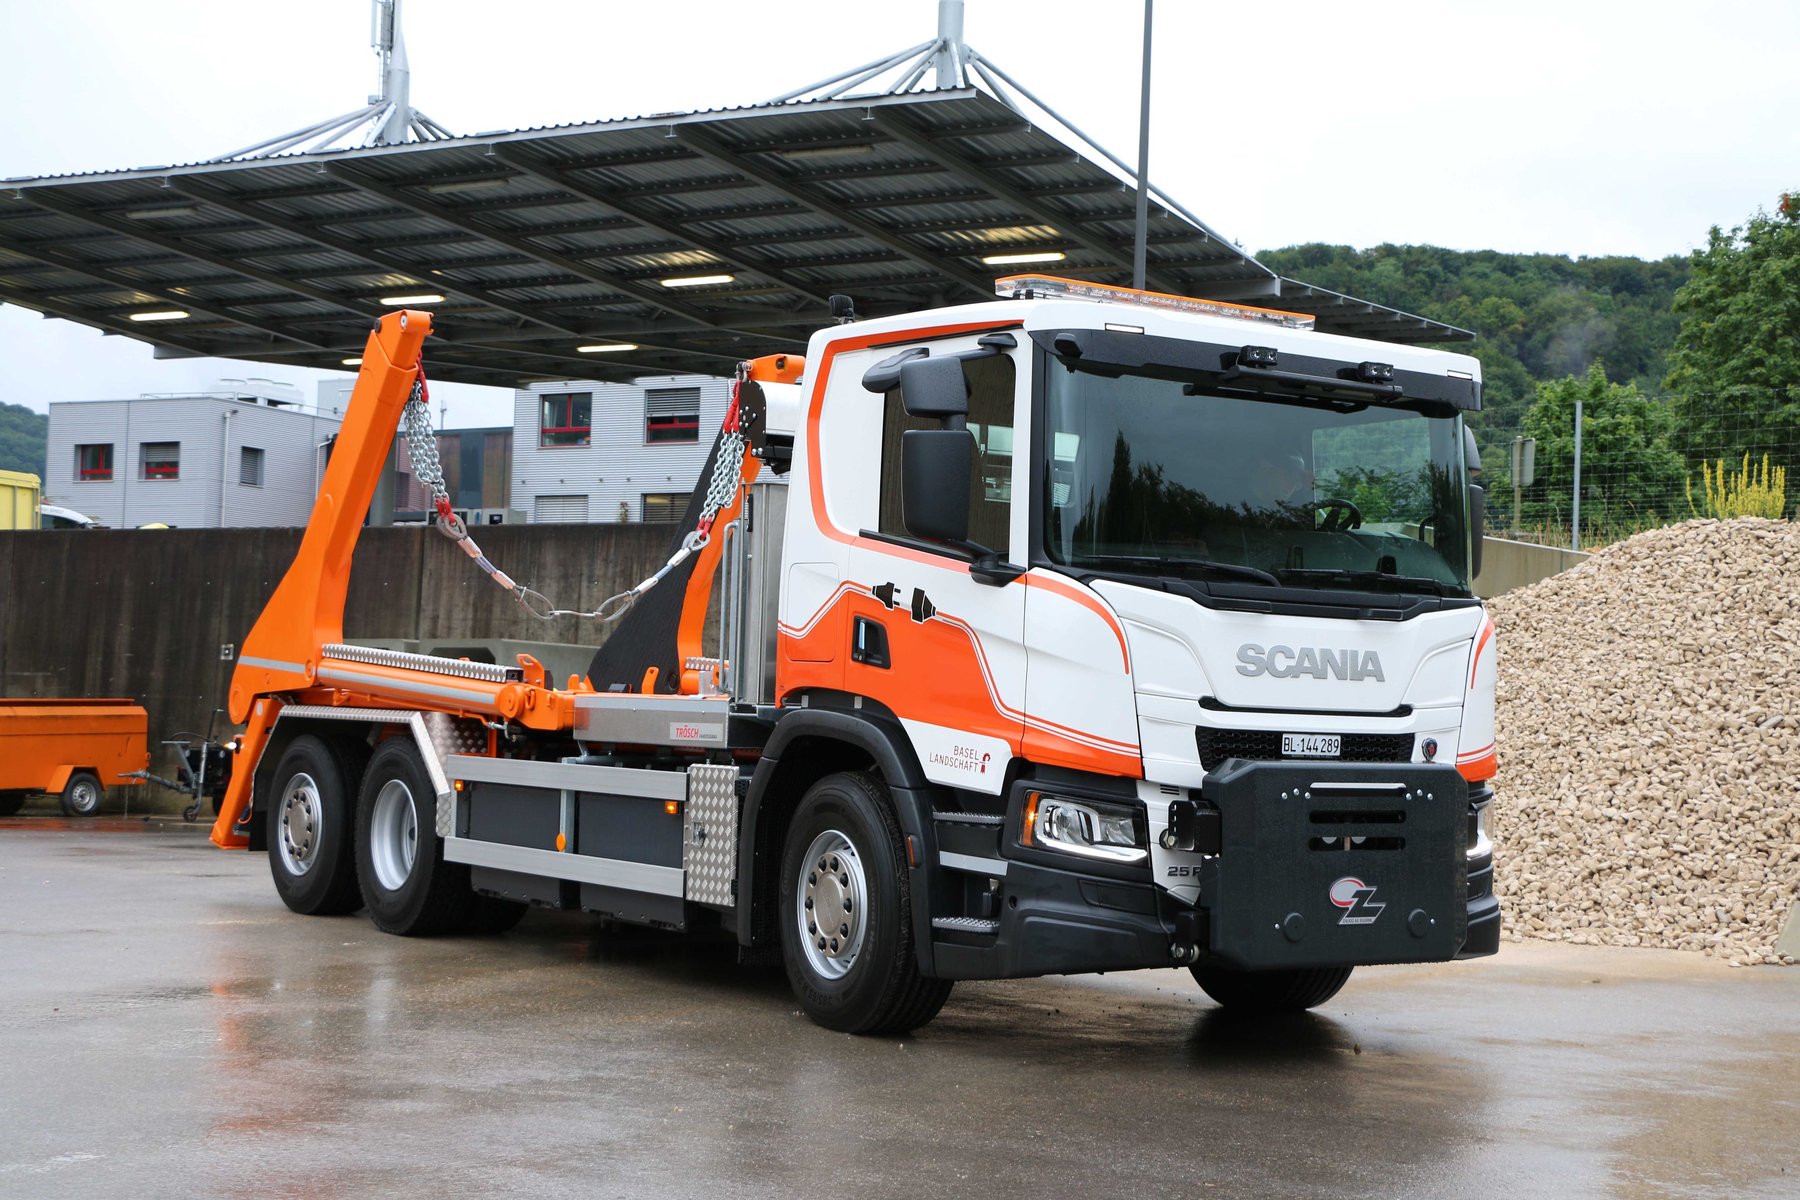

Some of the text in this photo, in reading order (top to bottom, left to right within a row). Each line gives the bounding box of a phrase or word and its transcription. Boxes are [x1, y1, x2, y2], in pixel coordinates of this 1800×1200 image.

[1235, 643, 1385, 682] SCANIA
[676, 725, 699, 738] TRÖSCH
[953, 745, 979, 760] BASEL
[929, 752, 979, 772] LANDSCHAFT
[1167, 866, 1190, 877] 25
